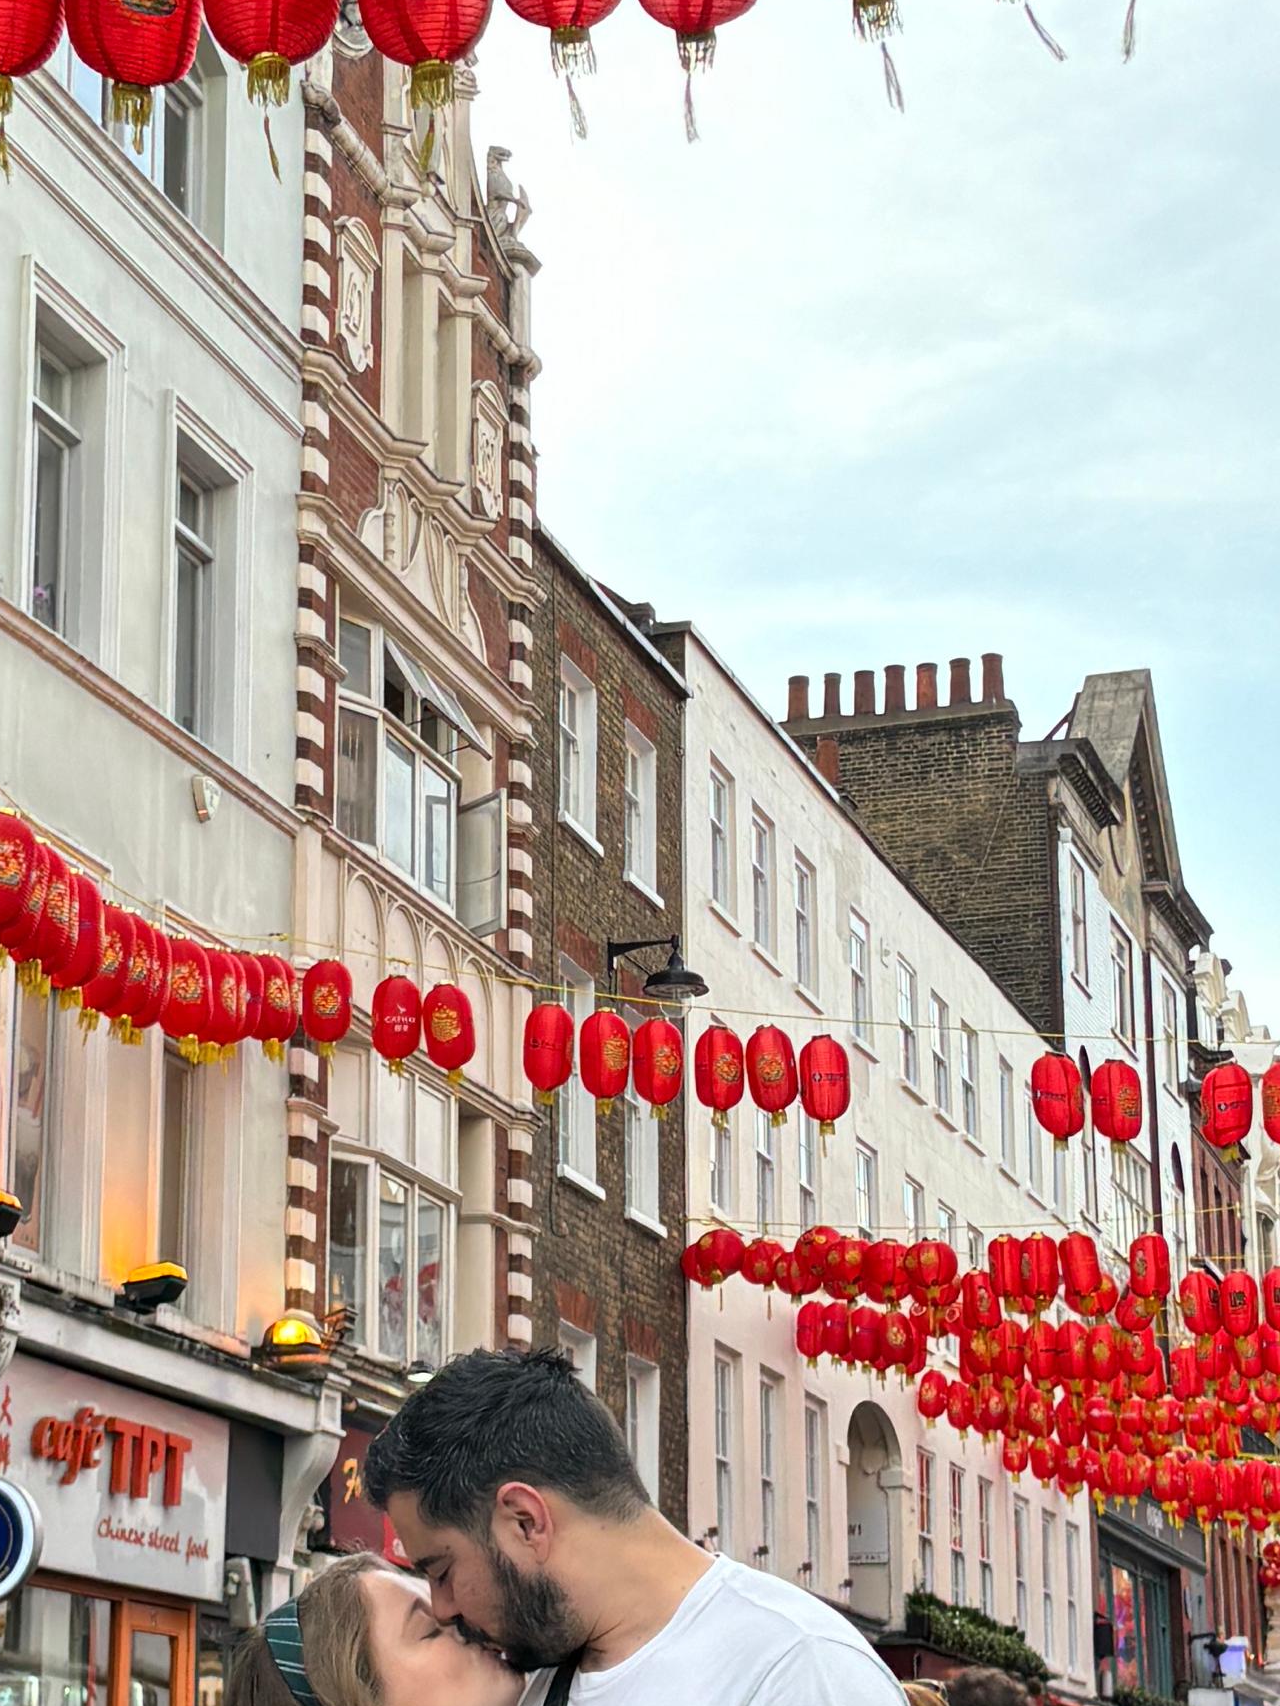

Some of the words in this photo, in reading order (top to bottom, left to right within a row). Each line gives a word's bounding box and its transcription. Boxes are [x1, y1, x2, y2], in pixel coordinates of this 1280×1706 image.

[105, 1416, 193, 1509] TPT
[97, 1515, 146, 1547] Chinese
[185, 1535, 210, 1566] food
